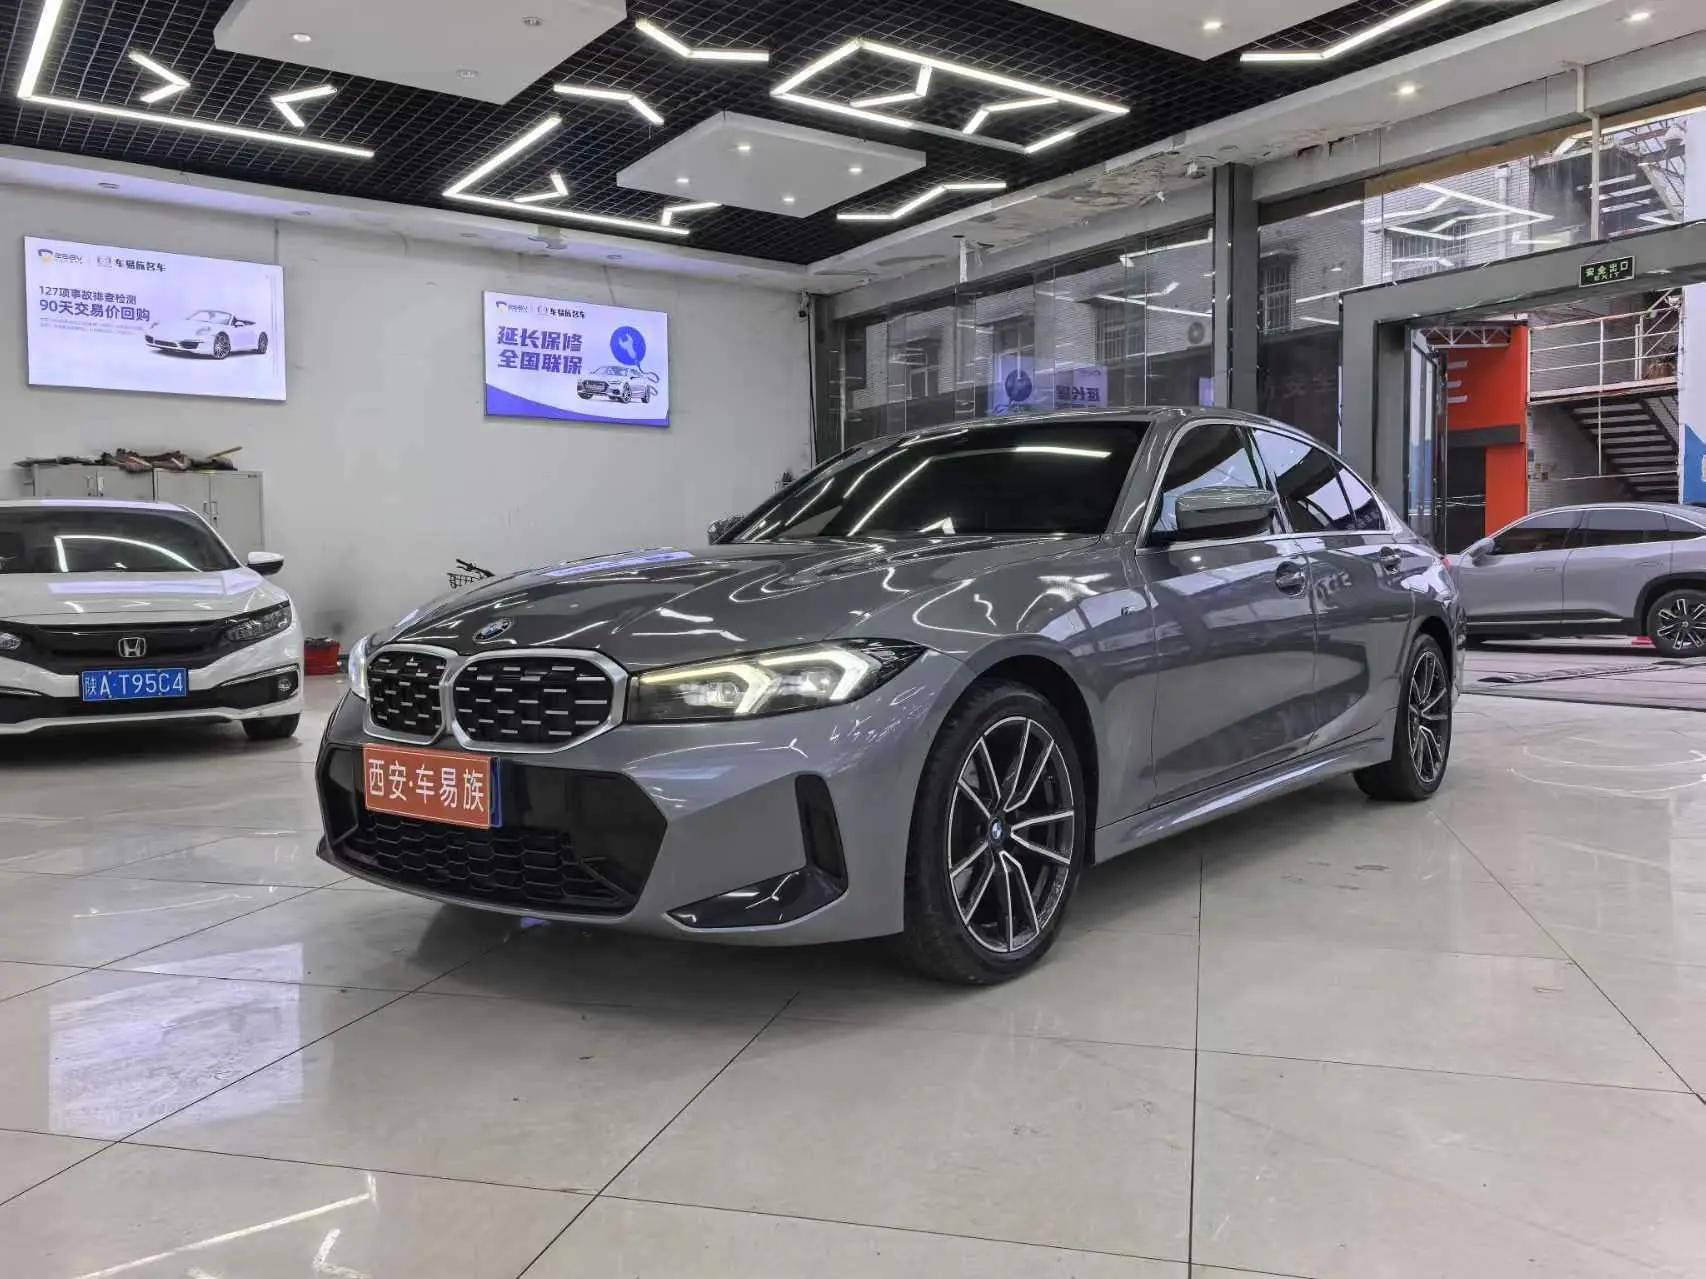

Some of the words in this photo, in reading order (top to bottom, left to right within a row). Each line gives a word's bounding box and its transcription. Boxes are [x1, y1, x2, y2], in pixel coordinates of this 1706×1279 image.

[1585, 261, 1629, 277] 安全出口
[1593, 272, 1620, 281] EXIT
[39, 285, 137, 305] 127项事故排查检测
[39, 299, 150, 322] 90天交易价回购
[497, 325, 583, 352] 延长保修
[497, 349, 583, 375] 全国联保
[368, 758, 485, 812] 西安·车易族
